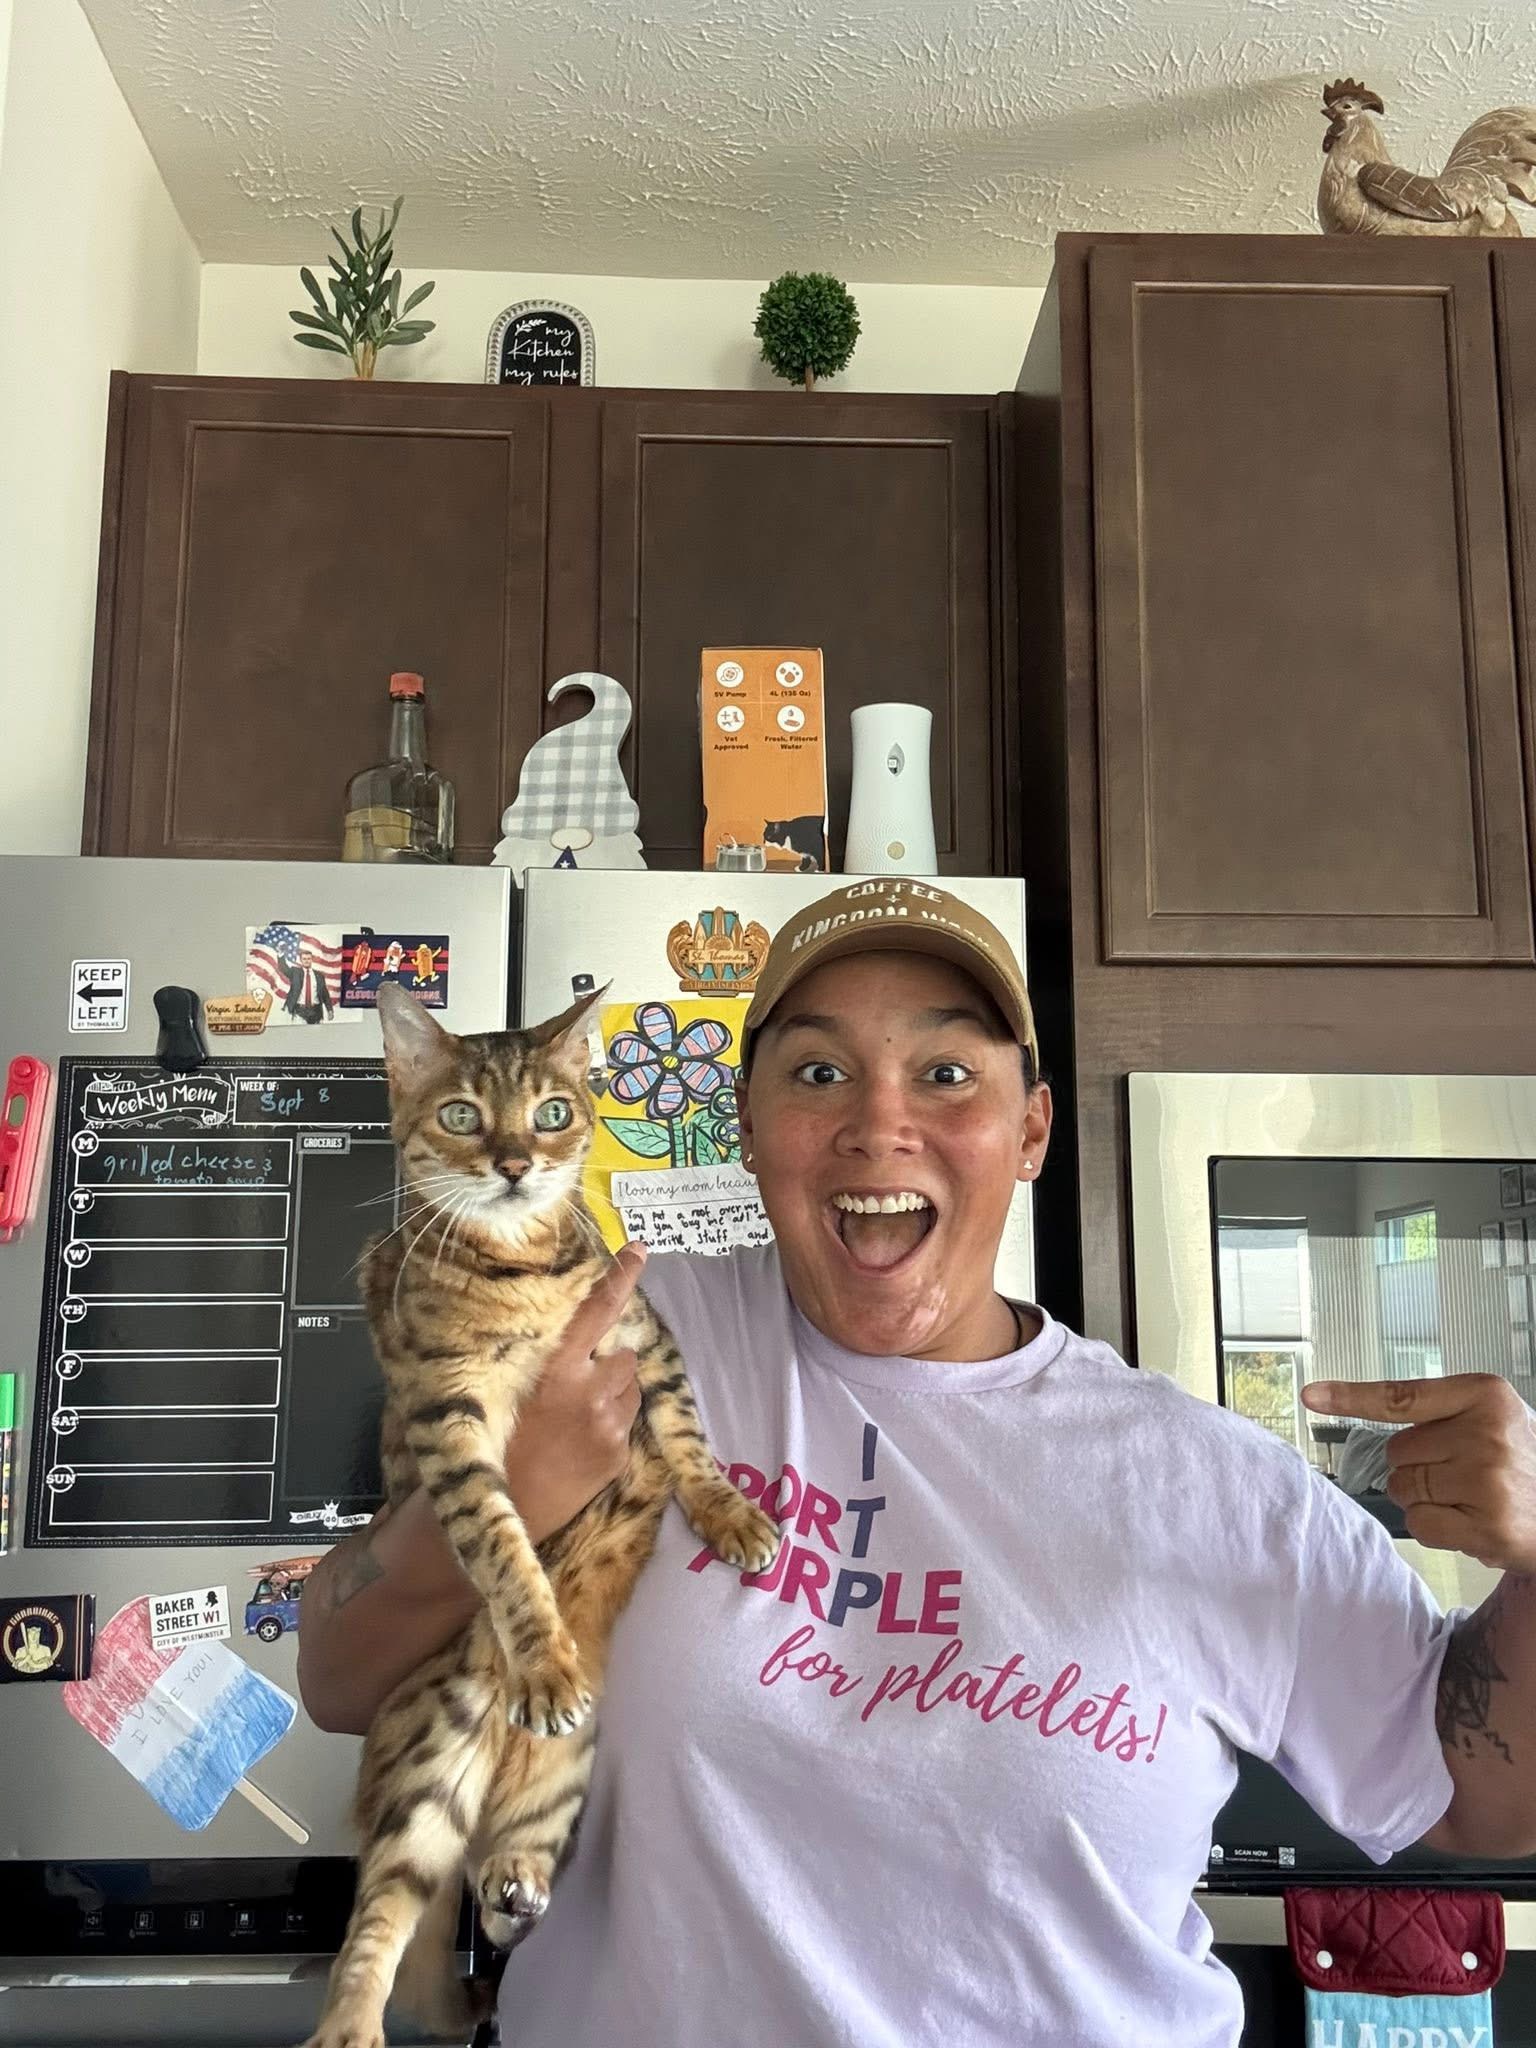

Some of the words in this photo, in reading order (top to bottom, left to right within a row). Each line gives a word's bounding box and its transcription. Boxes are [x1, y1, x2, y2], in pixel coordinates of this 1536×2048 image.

[545, 326, 575, 347] my
[507, 339, 575, 363] Kitchen
[505, 367, 535, 386] my
[543, 359, 578, 385] rules
[726, 691, 747, 699] Pump
[845, 882, 944, 904] COFFEE
[78, 968, 122, 981] KEEP
[78, 1006, 119, 1019] LEFT
[206, 1004, 231, 1015] Virgin
[234, 1004, 266, 1013] Islands
[240, 1081, 265, 1092] WEEK
[97, 1089, 168, 1116] Weekly
[172, 1085, 218, 1104] Menu
[260, 1088, 304, 1116] Sept
[318, 1087, 330, 1103] 8
[77, 1137, 94, 1149] M
[303, 1137, 343, 1148] GROCERIES
[104, 1145, 175, 1182] grilled
[181, 1146, 256, 1170] cheese
[154, 1172, 213, 1185] tomato
[226, 1177, 265, 1190] soup
[625, 1182, 654, 1197] love
[656, 1185, 679, 1199] my
[682, 1183, 715, 1193] mom
[716, 1175, 757, 1189] becau
[73, 1193, 89, 1209] T
[719, 1204, 741, 1216] over
[747, 1228, 769, 1239] and
[69, 1249, 87, 1261] W
[63, 1305, 84, 1315] TH
[297, 1316, 330, 1328] NOTES
[62, 1360, 77, 1374] F
[51, 1416, 79, 1426] SAT
[861, 1422, 878, 1481] I
[46, 1474, 77, 1484] SUN
[713, 1456, 886, 1558] PORT
[686, 1533, 963, 1635] URPLE
[155, 1597, 195, 1616] BAKER
[156, 1613, 199, 1632] STREET
[203, 1610, 220, 1624] W1
[157, 1639, 170, 1647] CITY
[181, 1630, 224, 1643] WESTMINSTER
[759, 1624, 863, 1697] for
[861, 1638, 1167, 1764] platelets!
[151, 1686, 184, 1725] LOVE
